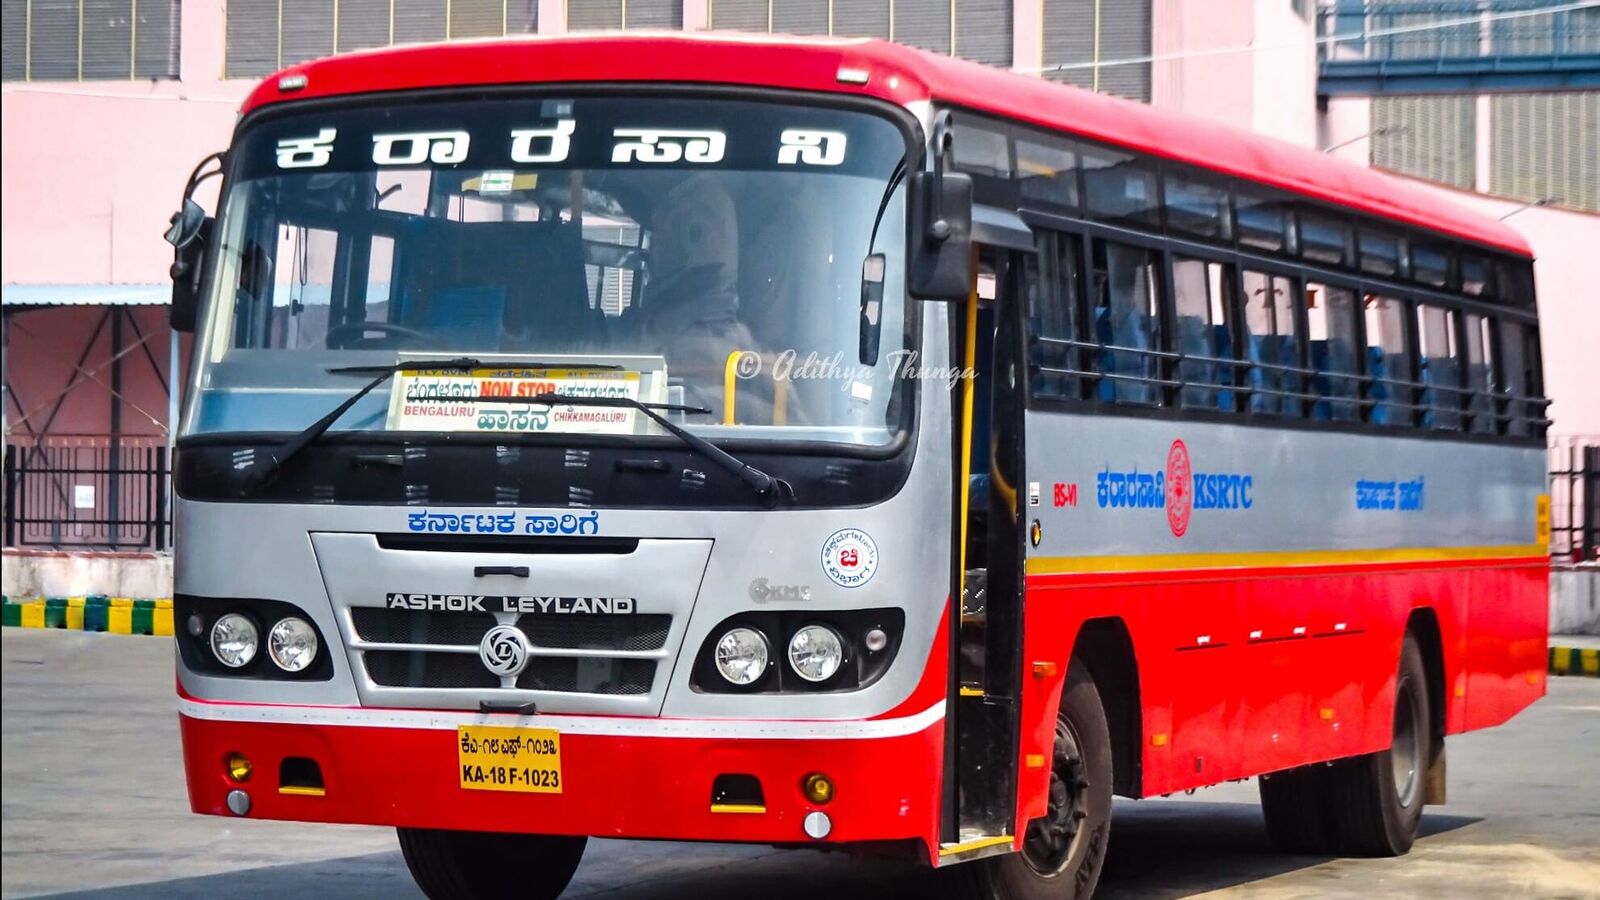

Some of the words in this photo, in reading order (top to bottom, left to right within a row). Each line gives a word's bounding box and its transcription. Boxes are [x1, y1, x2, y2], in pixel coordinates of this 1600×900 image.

[276, 127, 337, 169] ಕ
[511, 119, 576, 163] ರ
[480, 380, 513, 399] NON
[517, 382, 557, 400] STOP
[404, 405, 475, 417] BENGALURU
[477, 403, 551, 430] ಹಾಸನ
[553, 412, 627, 423] CHIKKAMAGALURU
[1193, 473, 1253, 510] KSRTC
[408, 509, 517, 533] ಕರ್ನಾಟಕ
[525, 511, 600, 535] ಸಾರಿಗೆ
[389, 594, 486, 612] ASHOK
[503, 598, 634, 614] LEYLAND
